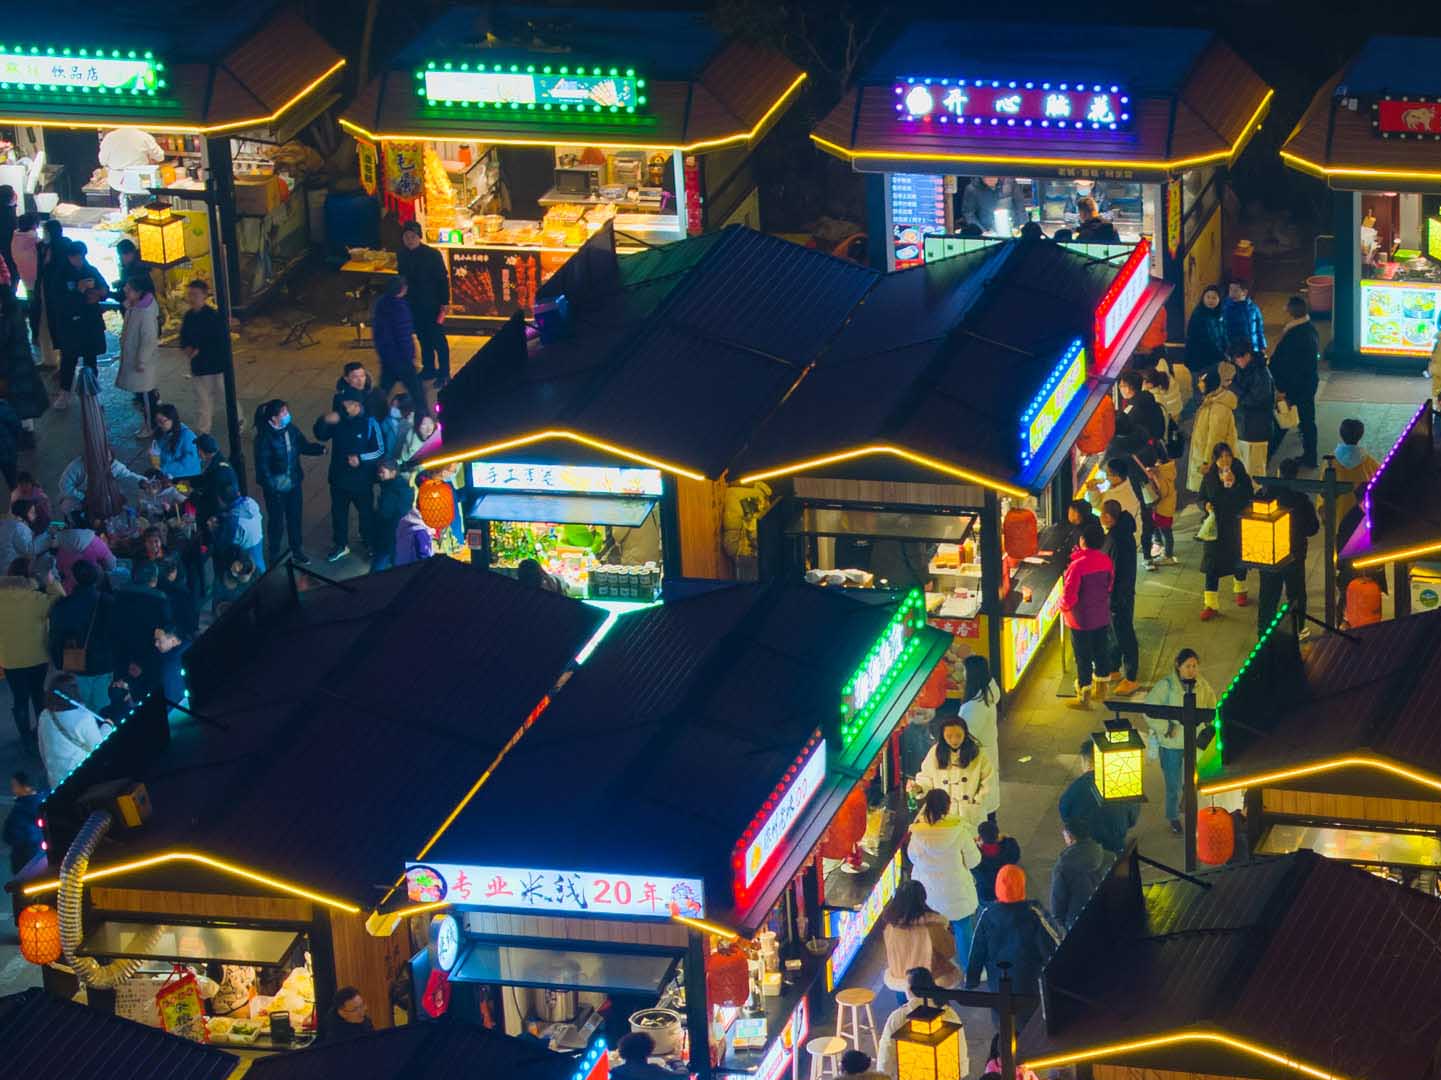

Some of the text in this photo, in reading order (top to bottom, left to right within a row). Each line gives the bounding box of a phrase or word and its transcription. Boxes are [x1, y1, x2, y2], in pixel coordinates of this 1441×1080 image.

[451, 869, 664, 912] 专业米线20年
